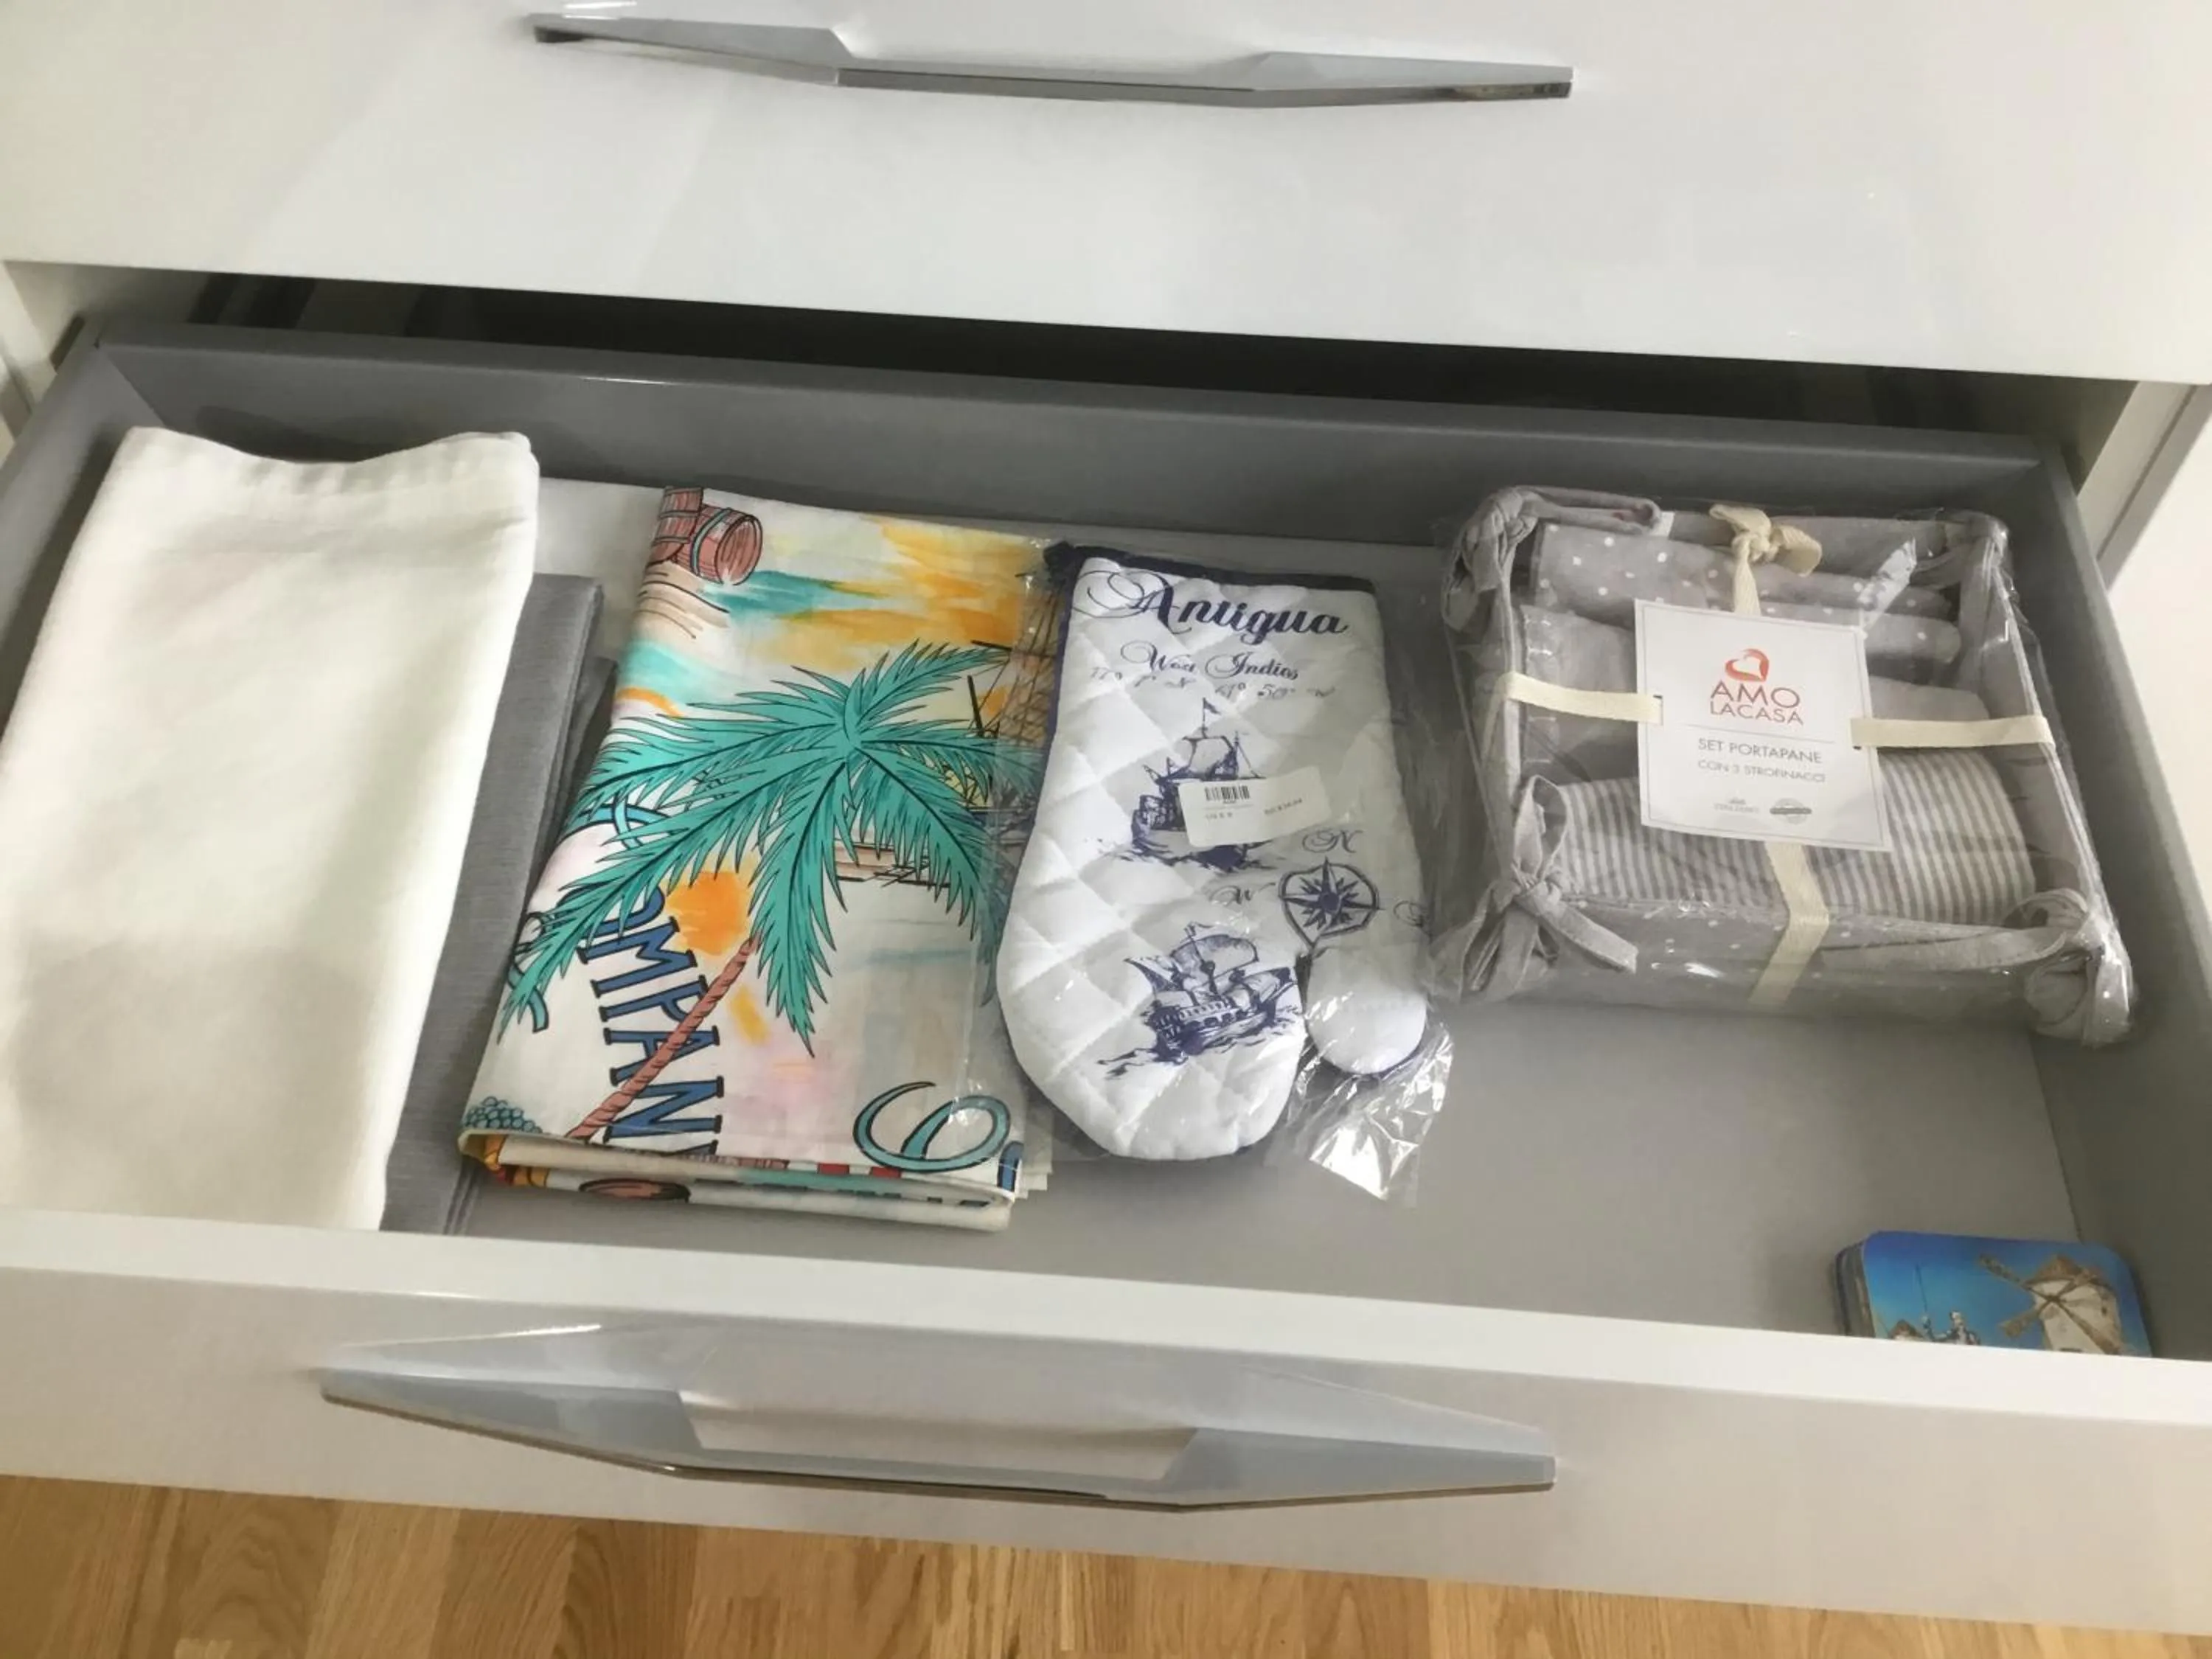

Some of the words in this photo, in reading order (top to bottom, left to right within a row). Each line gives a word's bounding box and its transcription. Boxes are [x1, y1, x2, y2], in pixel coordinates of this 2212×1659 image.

[1073, 570, 1349, 645] Antigua
[1204, 651, 1299, 681] Indies
[1709, 681, 1801, 709] AMO
[1709, 700, 1804, 726] LACASA
[1698, 737, 1725, 752] SET
[1729, 742, 1823, 764] PORTAPANE
[1697, 759, 1730, 773] CON
